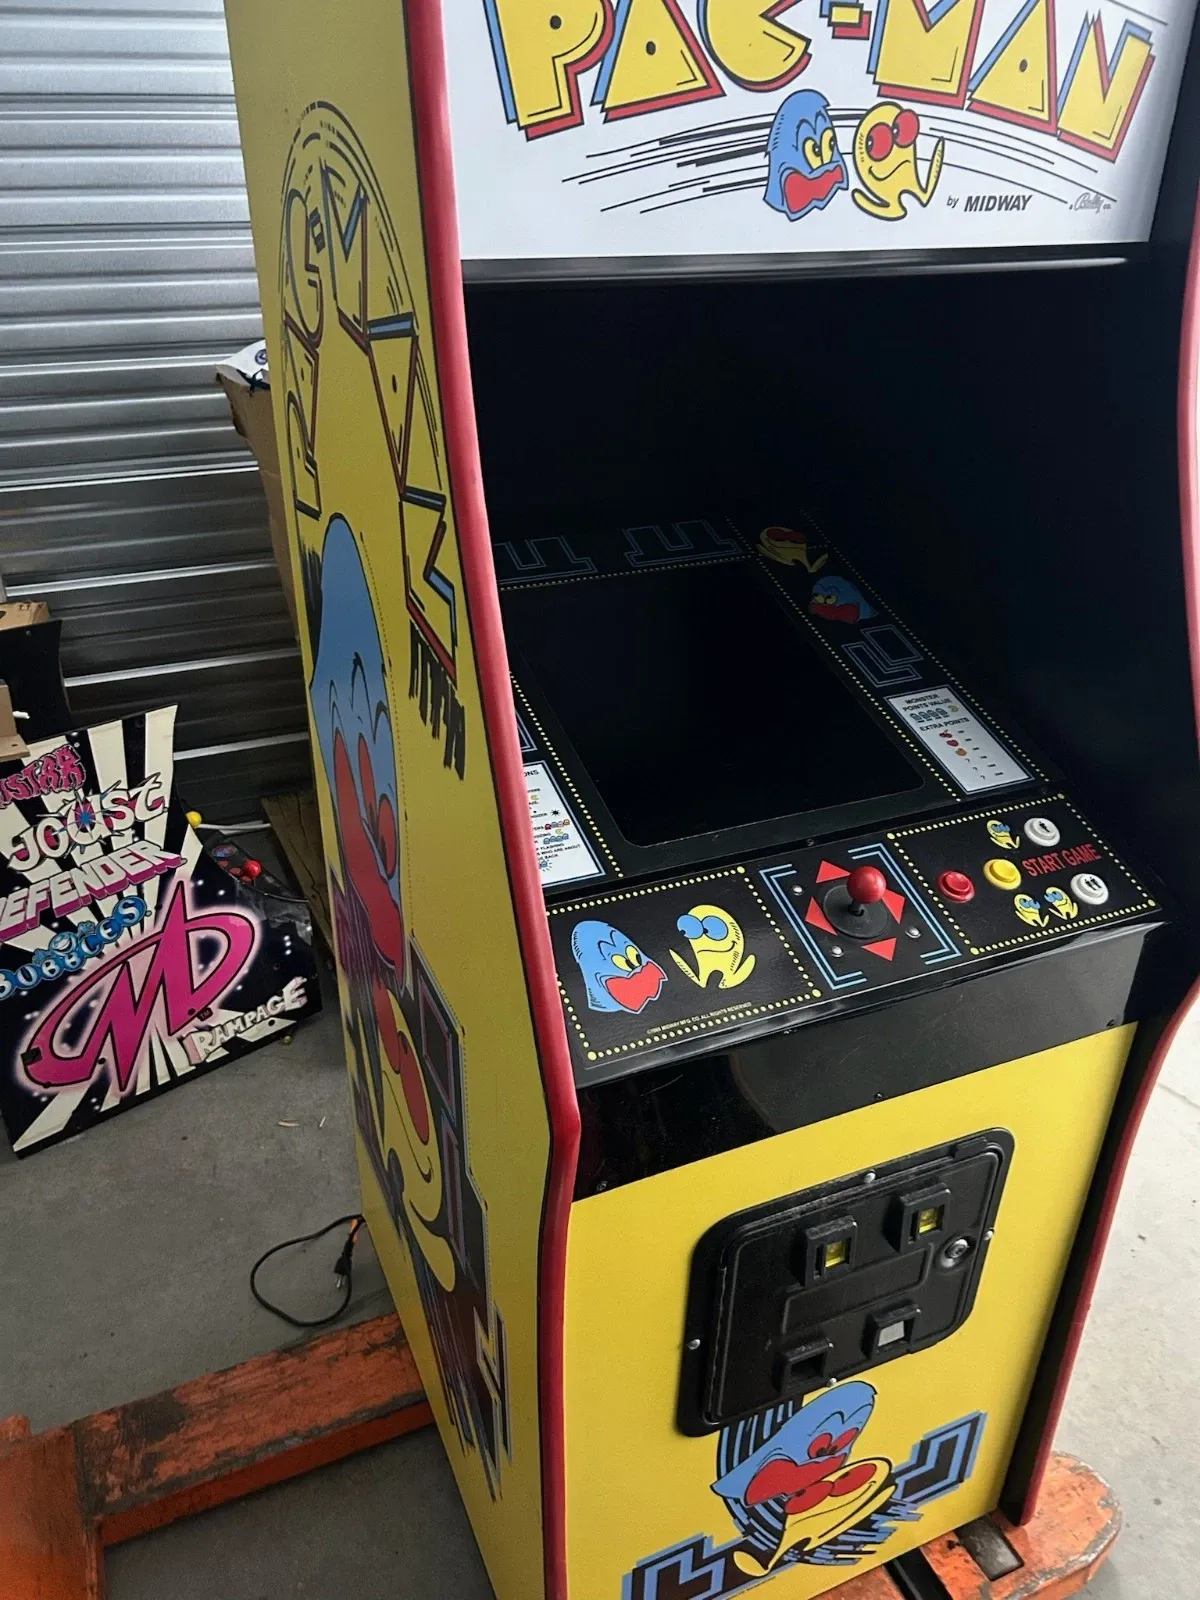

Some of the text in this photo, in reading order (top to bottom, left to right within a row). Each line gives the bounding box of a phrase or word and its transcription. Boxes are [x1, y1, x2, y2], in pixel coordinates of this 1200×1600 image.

[484, 0, 1156, 163] PAC-MAN
[946, 195, 960, 209] by
[964, 194, 1033, 212] MIDWAY
[902, 702, 929, 711] POINTS
[919, 722, 944, 731] EXTRA
[943, 717, 970, 726] POINTS
[1021, 843, 1103, 877] START GAME
[0, 839, 182, 942] EFENDER
[183, 976, 308, 1066] RAMPAGE
[709, 1008, 728, 1017] RIGHTS
